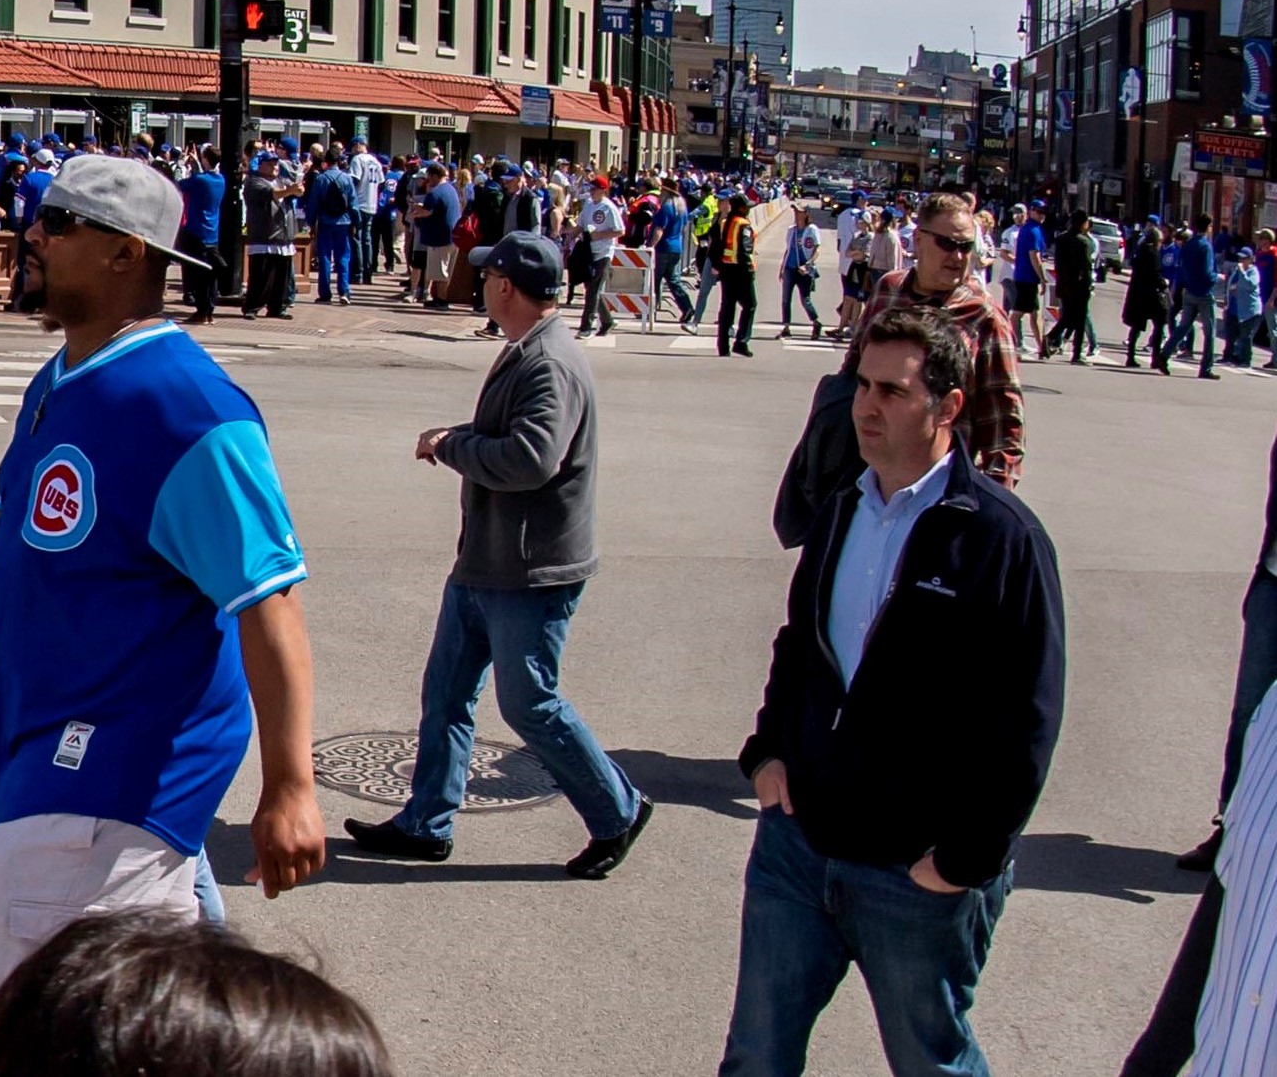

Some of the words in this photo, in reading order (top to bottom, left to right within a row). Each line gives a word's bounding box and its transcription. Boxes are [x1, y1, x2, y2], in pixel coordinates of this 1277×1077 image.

[284, 9, 307, 20] GATE
[286, 18, 304, 43] 3
[1198, 135, 1220, 145] BOX
[1222, 138, 1262, 151] OFFICE
[1206, 143, 1256, 159] TICKETS
